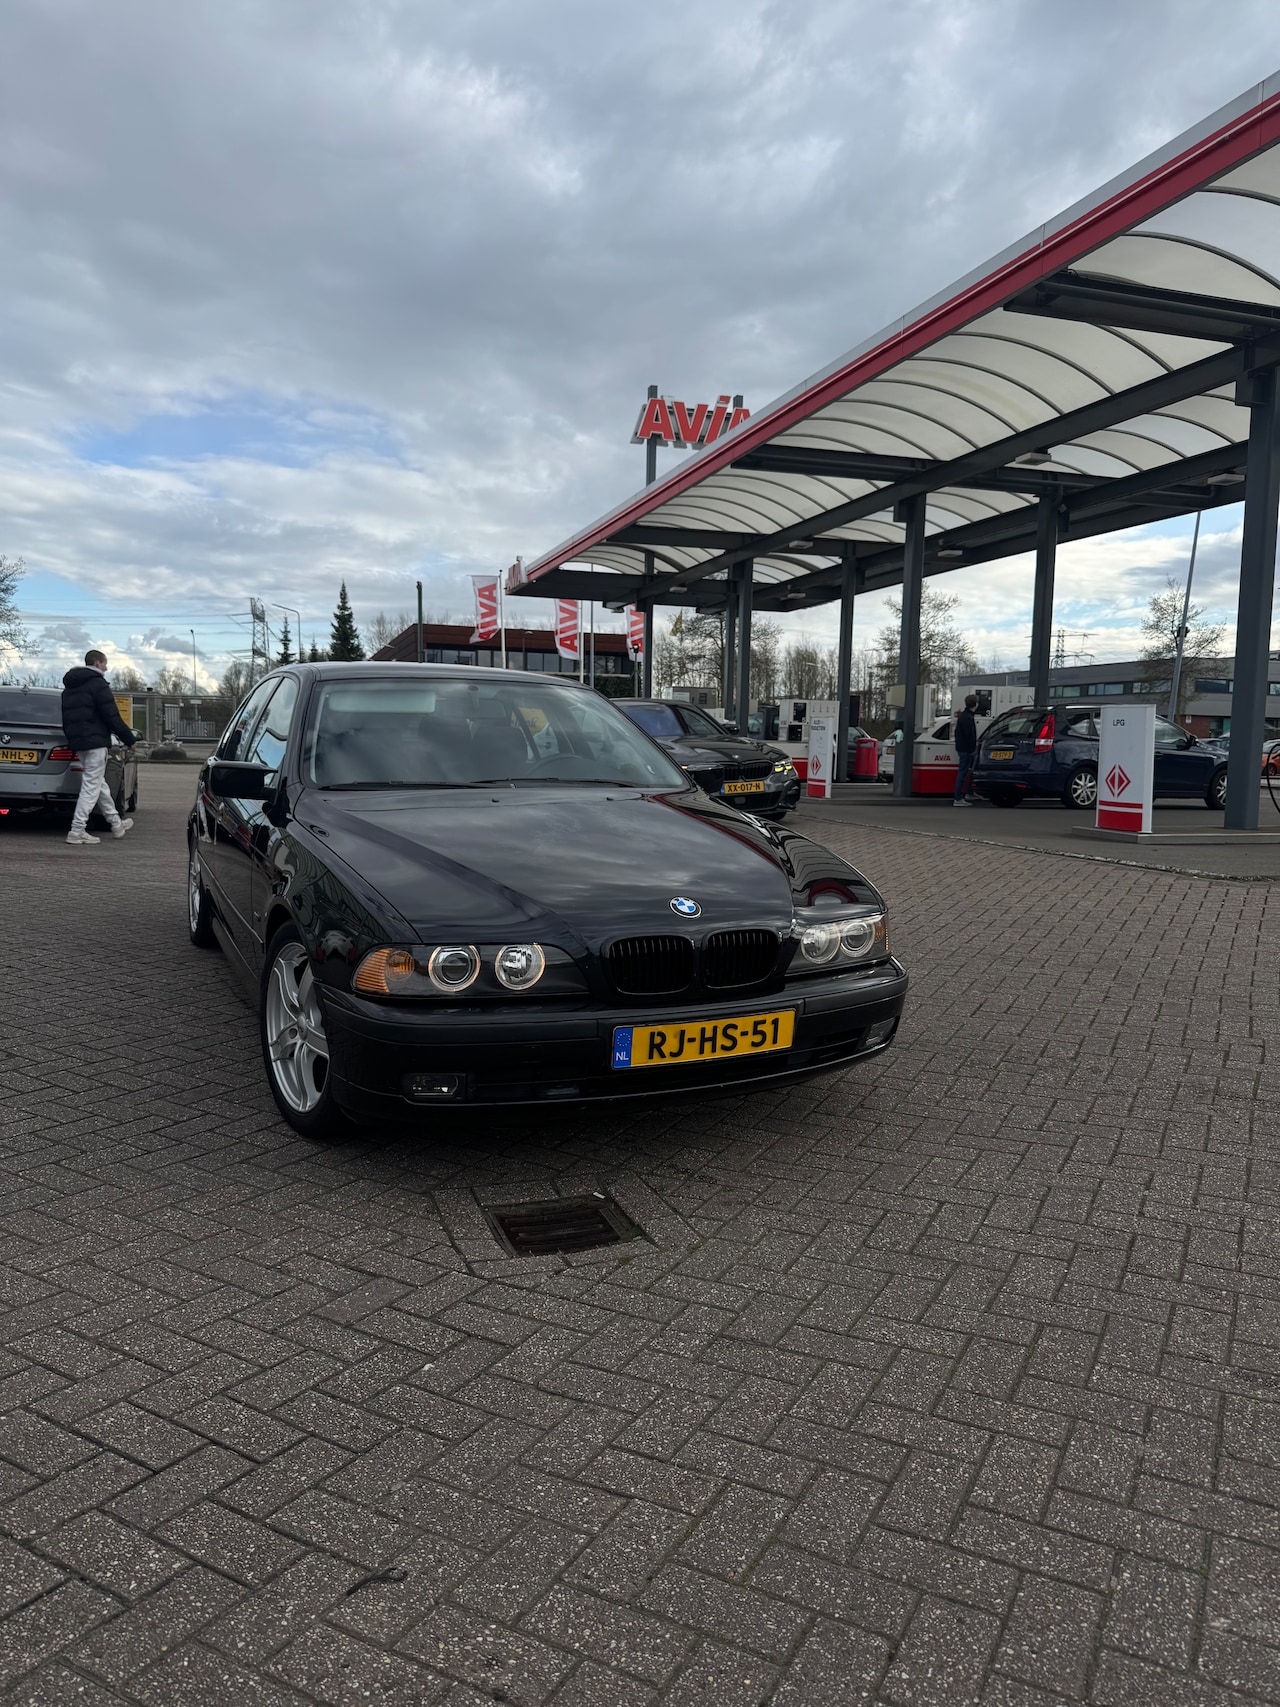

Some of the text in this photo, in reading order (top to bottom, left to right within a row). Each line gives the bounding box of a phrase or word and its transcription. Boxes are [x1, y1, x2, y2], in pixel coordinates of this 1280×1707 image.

[1112, 719, 1125, 727] LPG
[727, 783, 761, 792] XX-017-N
[648, 1017, 780, 1060] RJ-HS-51
[615, 1052, 629, 1061] NL
